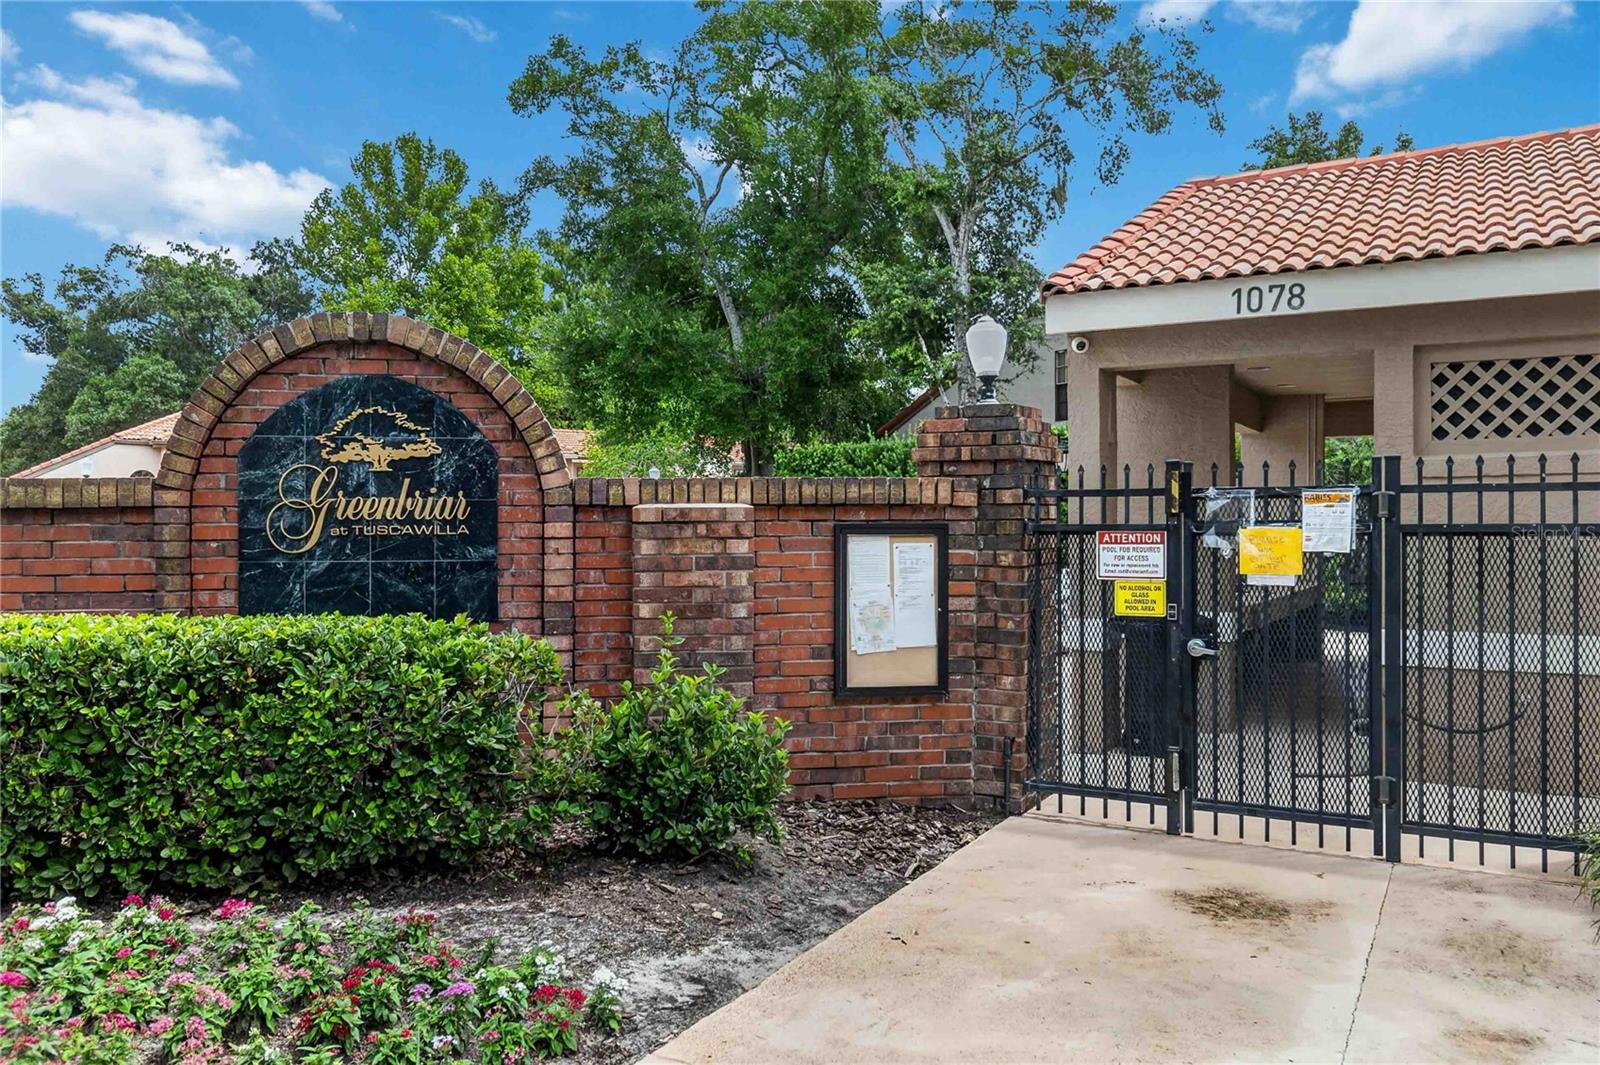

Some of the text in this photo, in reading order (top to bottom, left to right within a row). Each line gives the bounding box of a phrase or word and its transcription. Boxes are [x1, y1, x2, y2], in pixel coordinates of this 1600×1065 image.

[1231, 282, 1305, 315] 1078
[266, 464, 470, 554] Greenbriar
[330, 524, 470, 536] at TUSCAWILLA
[1103, 533, 1161, 544] ATTENTION
